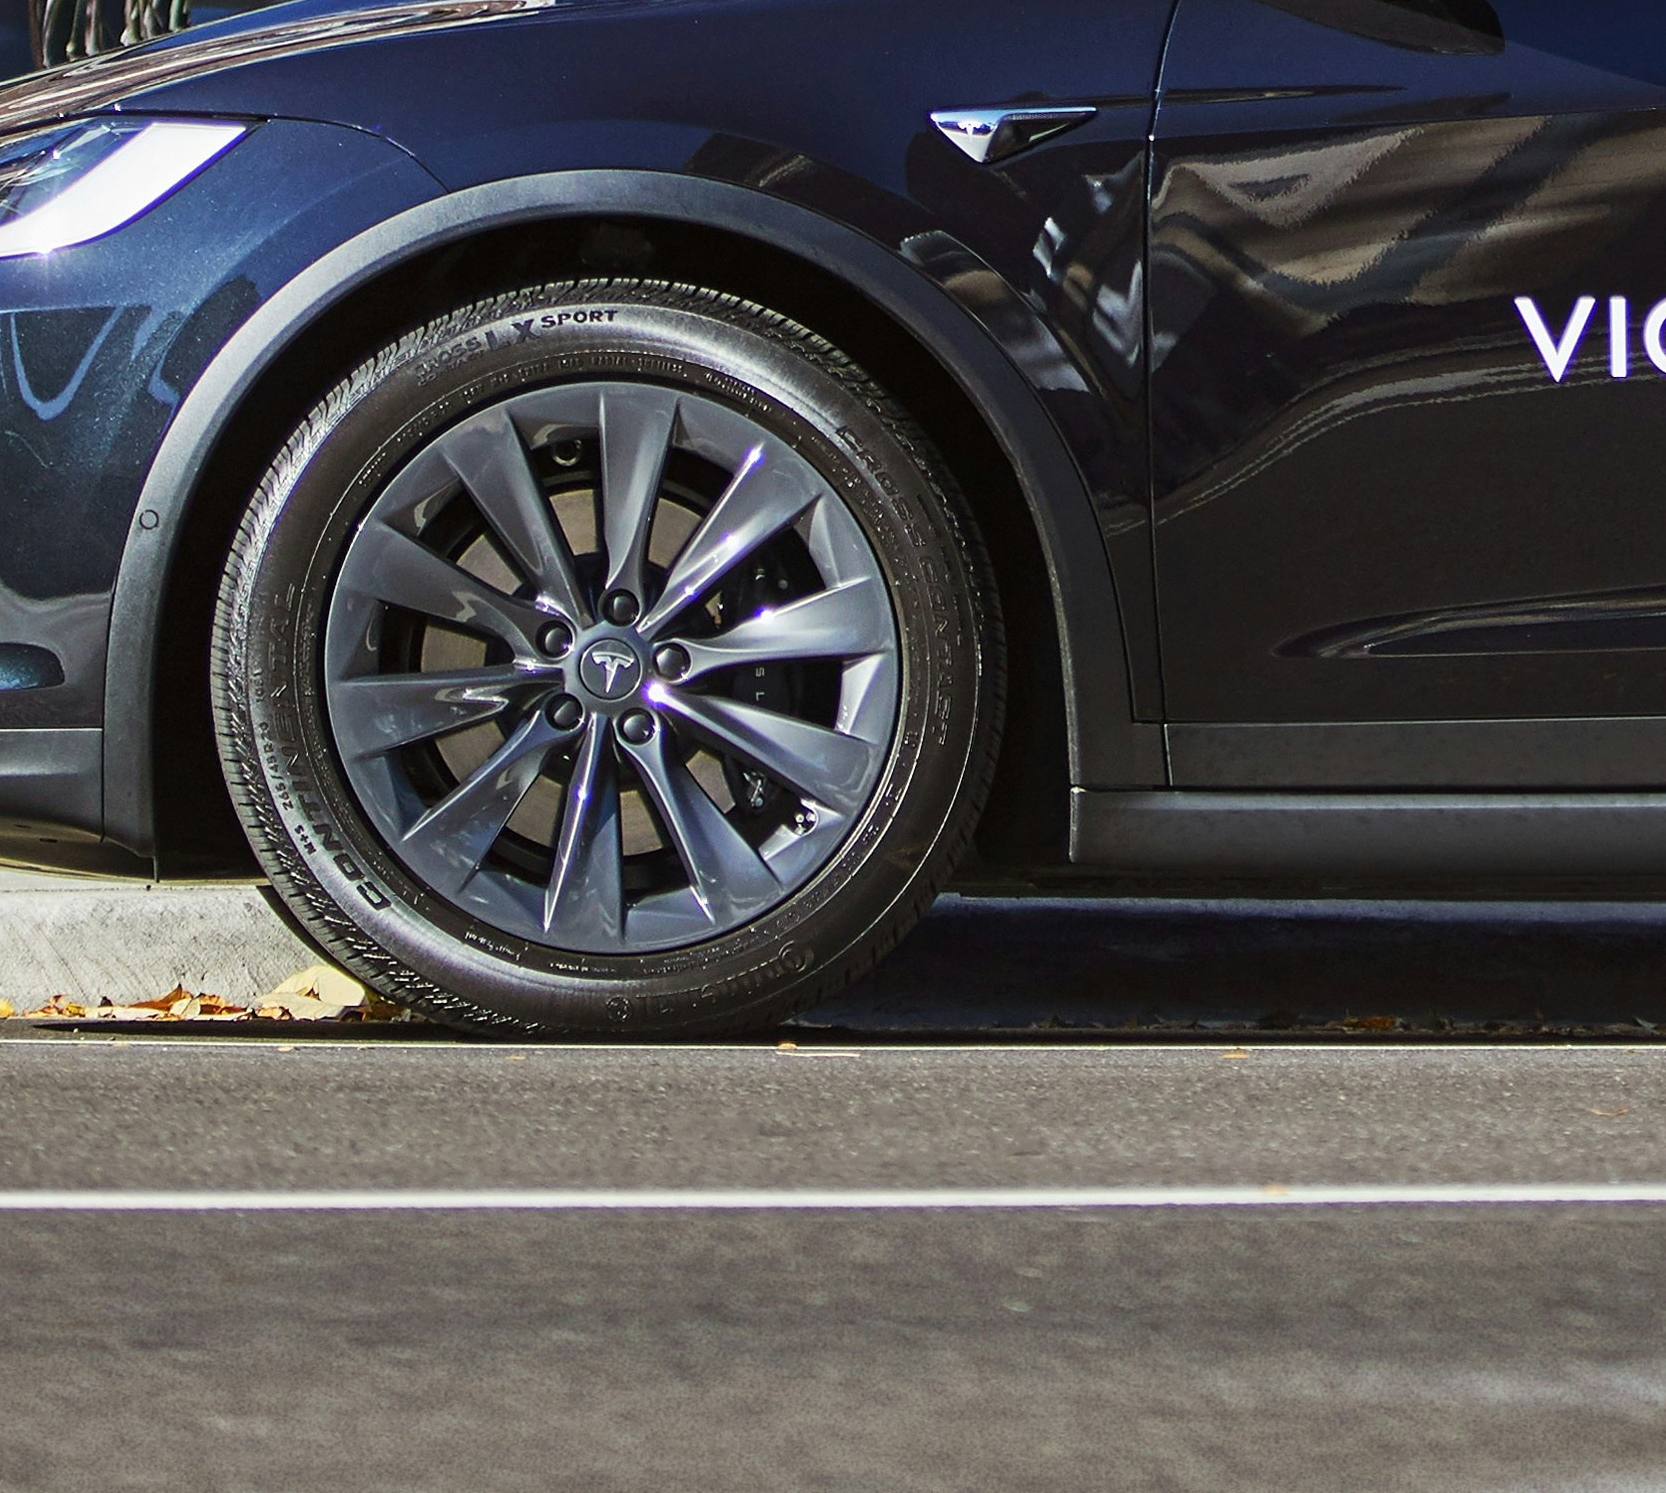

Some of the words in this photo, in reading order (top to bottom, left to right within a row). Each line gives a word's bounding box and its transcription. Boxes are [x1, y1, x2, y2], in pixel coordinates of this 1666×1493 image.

[484, 318, 542, 352] LX
[541, 309, 619, 329] SPORT
[268, 582, 392, 911] CONTINENTAL
[293, 824, 317, 855] M+S
